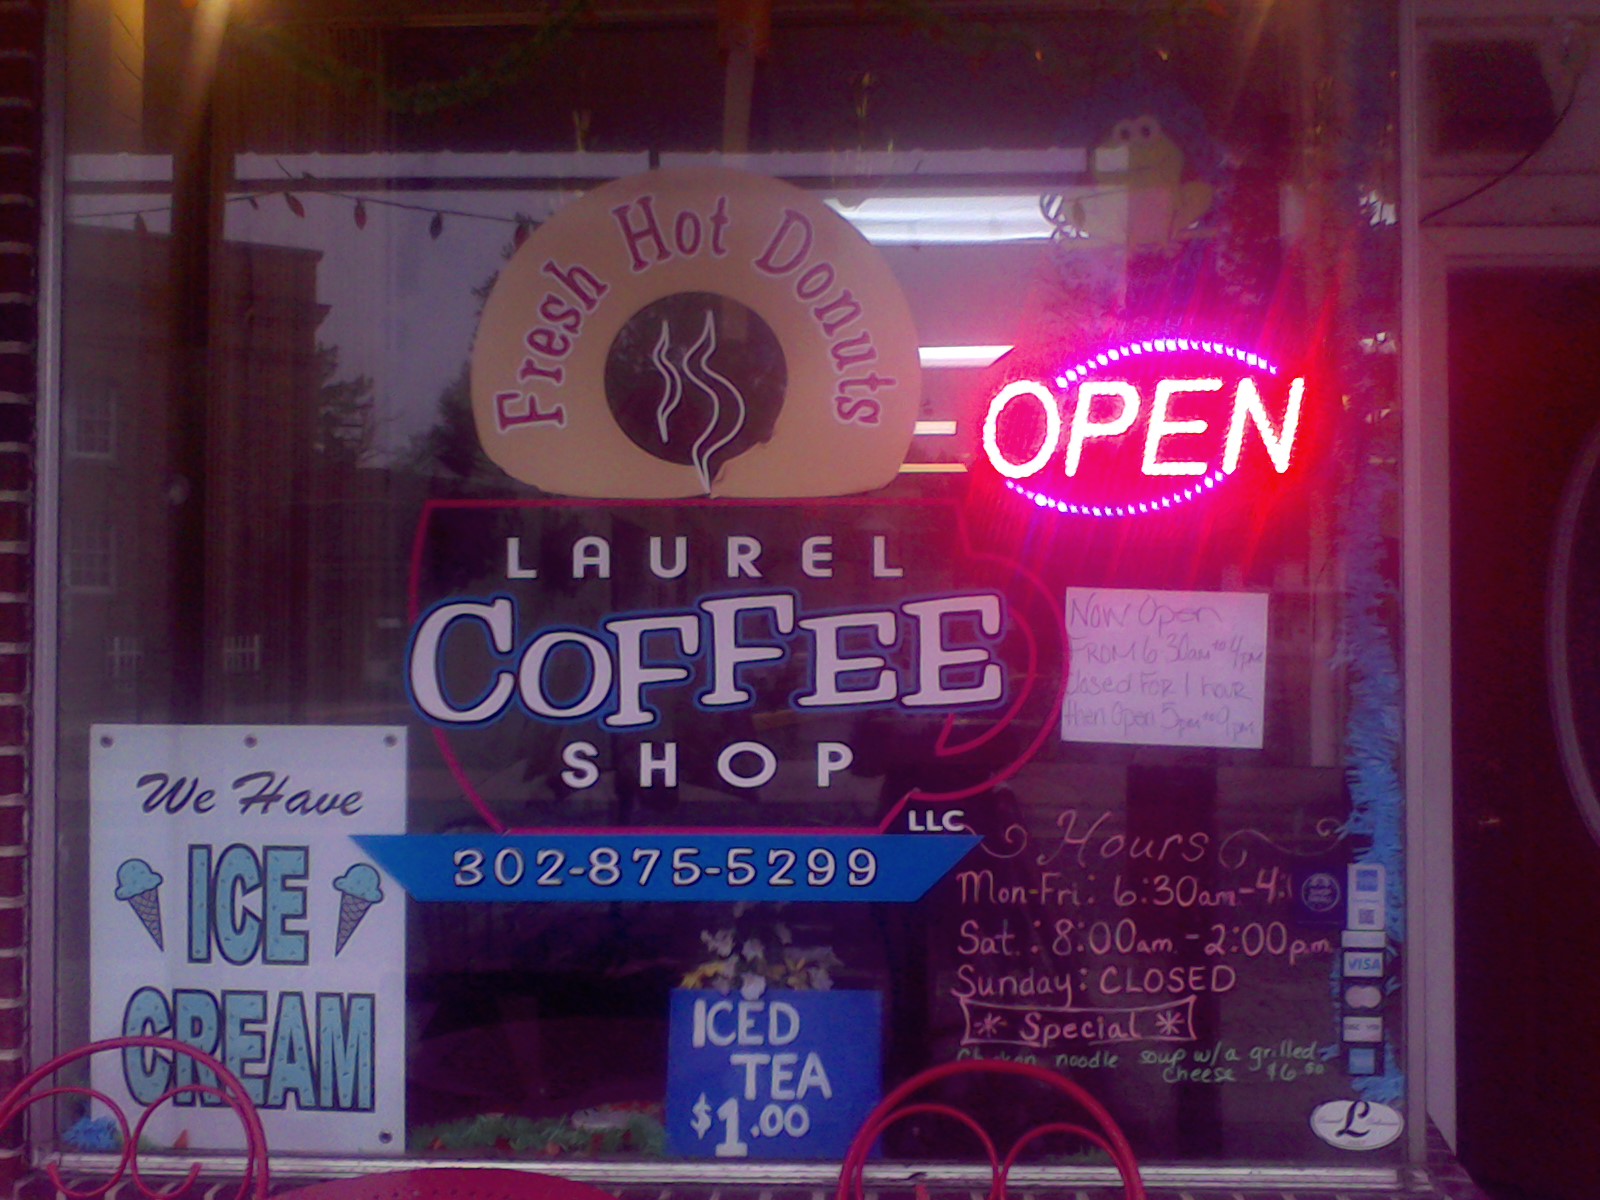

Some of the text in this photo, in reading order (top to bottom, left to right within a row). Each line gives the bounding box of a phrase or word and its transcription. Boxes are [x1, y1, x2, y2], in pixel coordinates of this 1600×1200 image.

[494, 195, 897, 432] Fresh Hot Donuts
[983, 377, 1304, 479] OPEN
[507, 535, 903, 579] LAUREL
[1138, 594, 1222, 637] Open
[408, 591, 1004, 729] COFFEE
[561, 742, 853, 788] SHOP
[137, 771, 364, 816] We Have
[907, 810, 965, 833] LLC
[1037, 810, 1209, 868] Hours
[452, 848, 878, 887] 302-875-5299
[187, 843, 310, 966] ICE
[1100, 965, 1235, 994] CLOSED
[1347, 957, 1381, 971] VISA
[692, 998, 800, 1048] ICED
[1020, 1011, 1141, 1047] Special
[122, 986, 376, 1113] CREAM
[1056, 1051, 1119, 1068] noodle
[1249, 1040, 1317, 1071] grilled
[730, 1052, 833, 1100] TEA
[690, 1092, 810, 1157] $1.00
